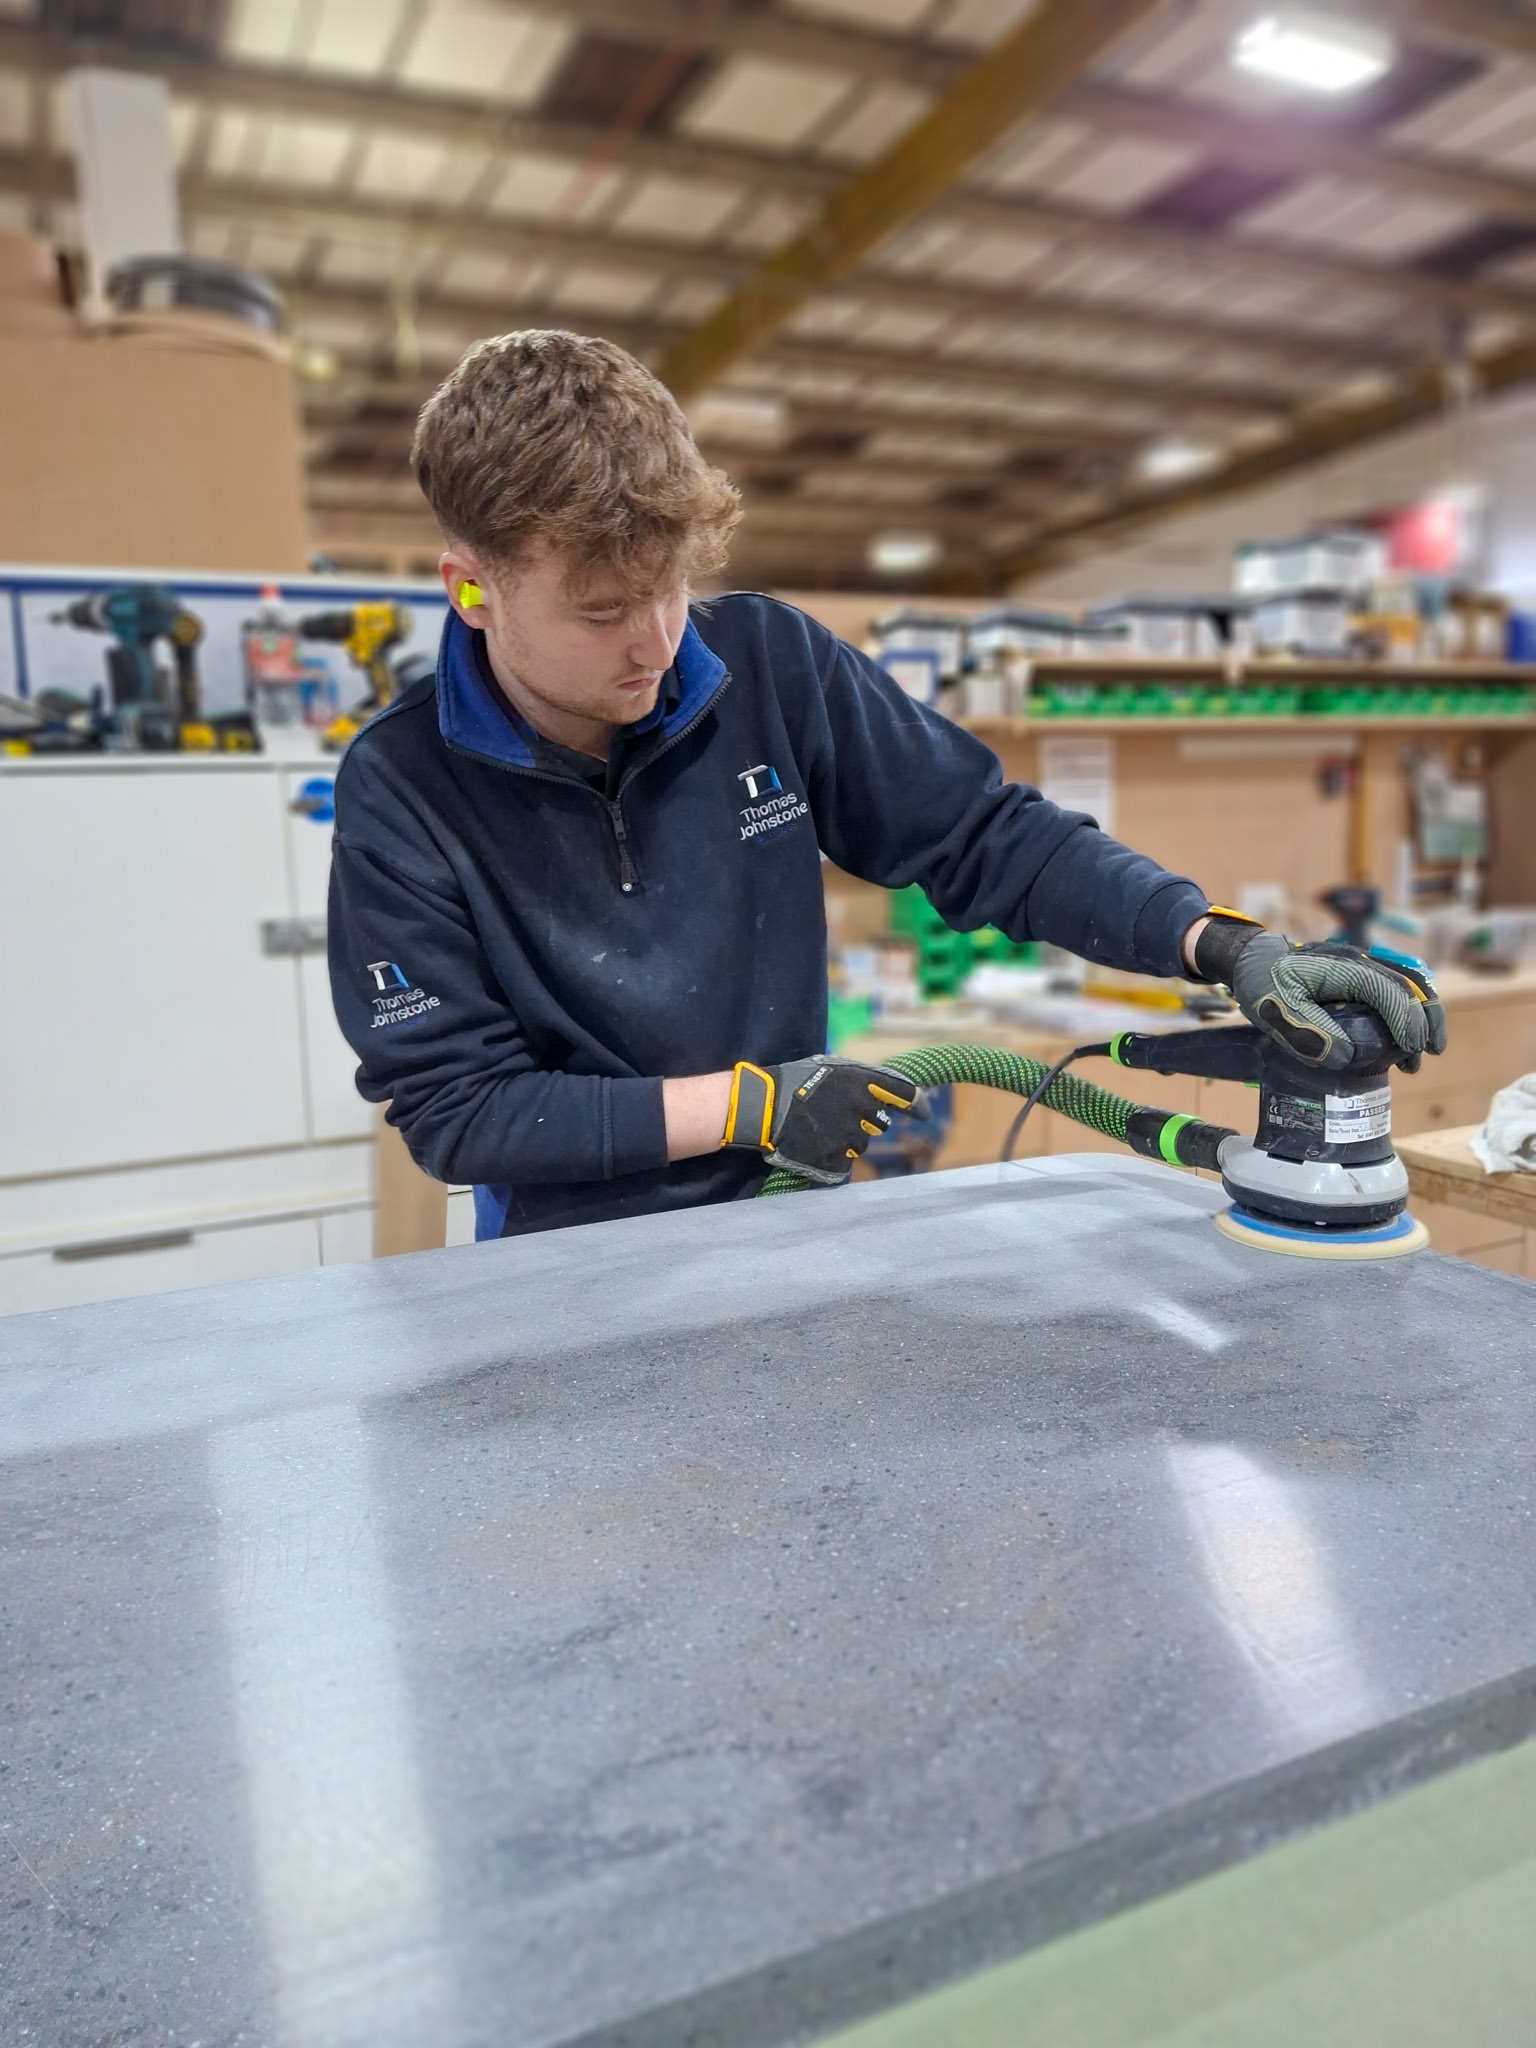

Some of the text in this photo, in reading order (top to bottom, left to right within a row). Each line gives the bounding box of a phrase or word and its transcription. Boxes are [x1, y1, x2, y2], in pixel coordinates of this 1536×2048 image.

[739, 792, 798, 822] Thomas
[740, 802, 809, 841] Johnstone
[370, 996, 441, 1029] Johnstone
[371, 988, 426, 1013] Thomas
[1359, 1105, 1386, 1118] PASSED
